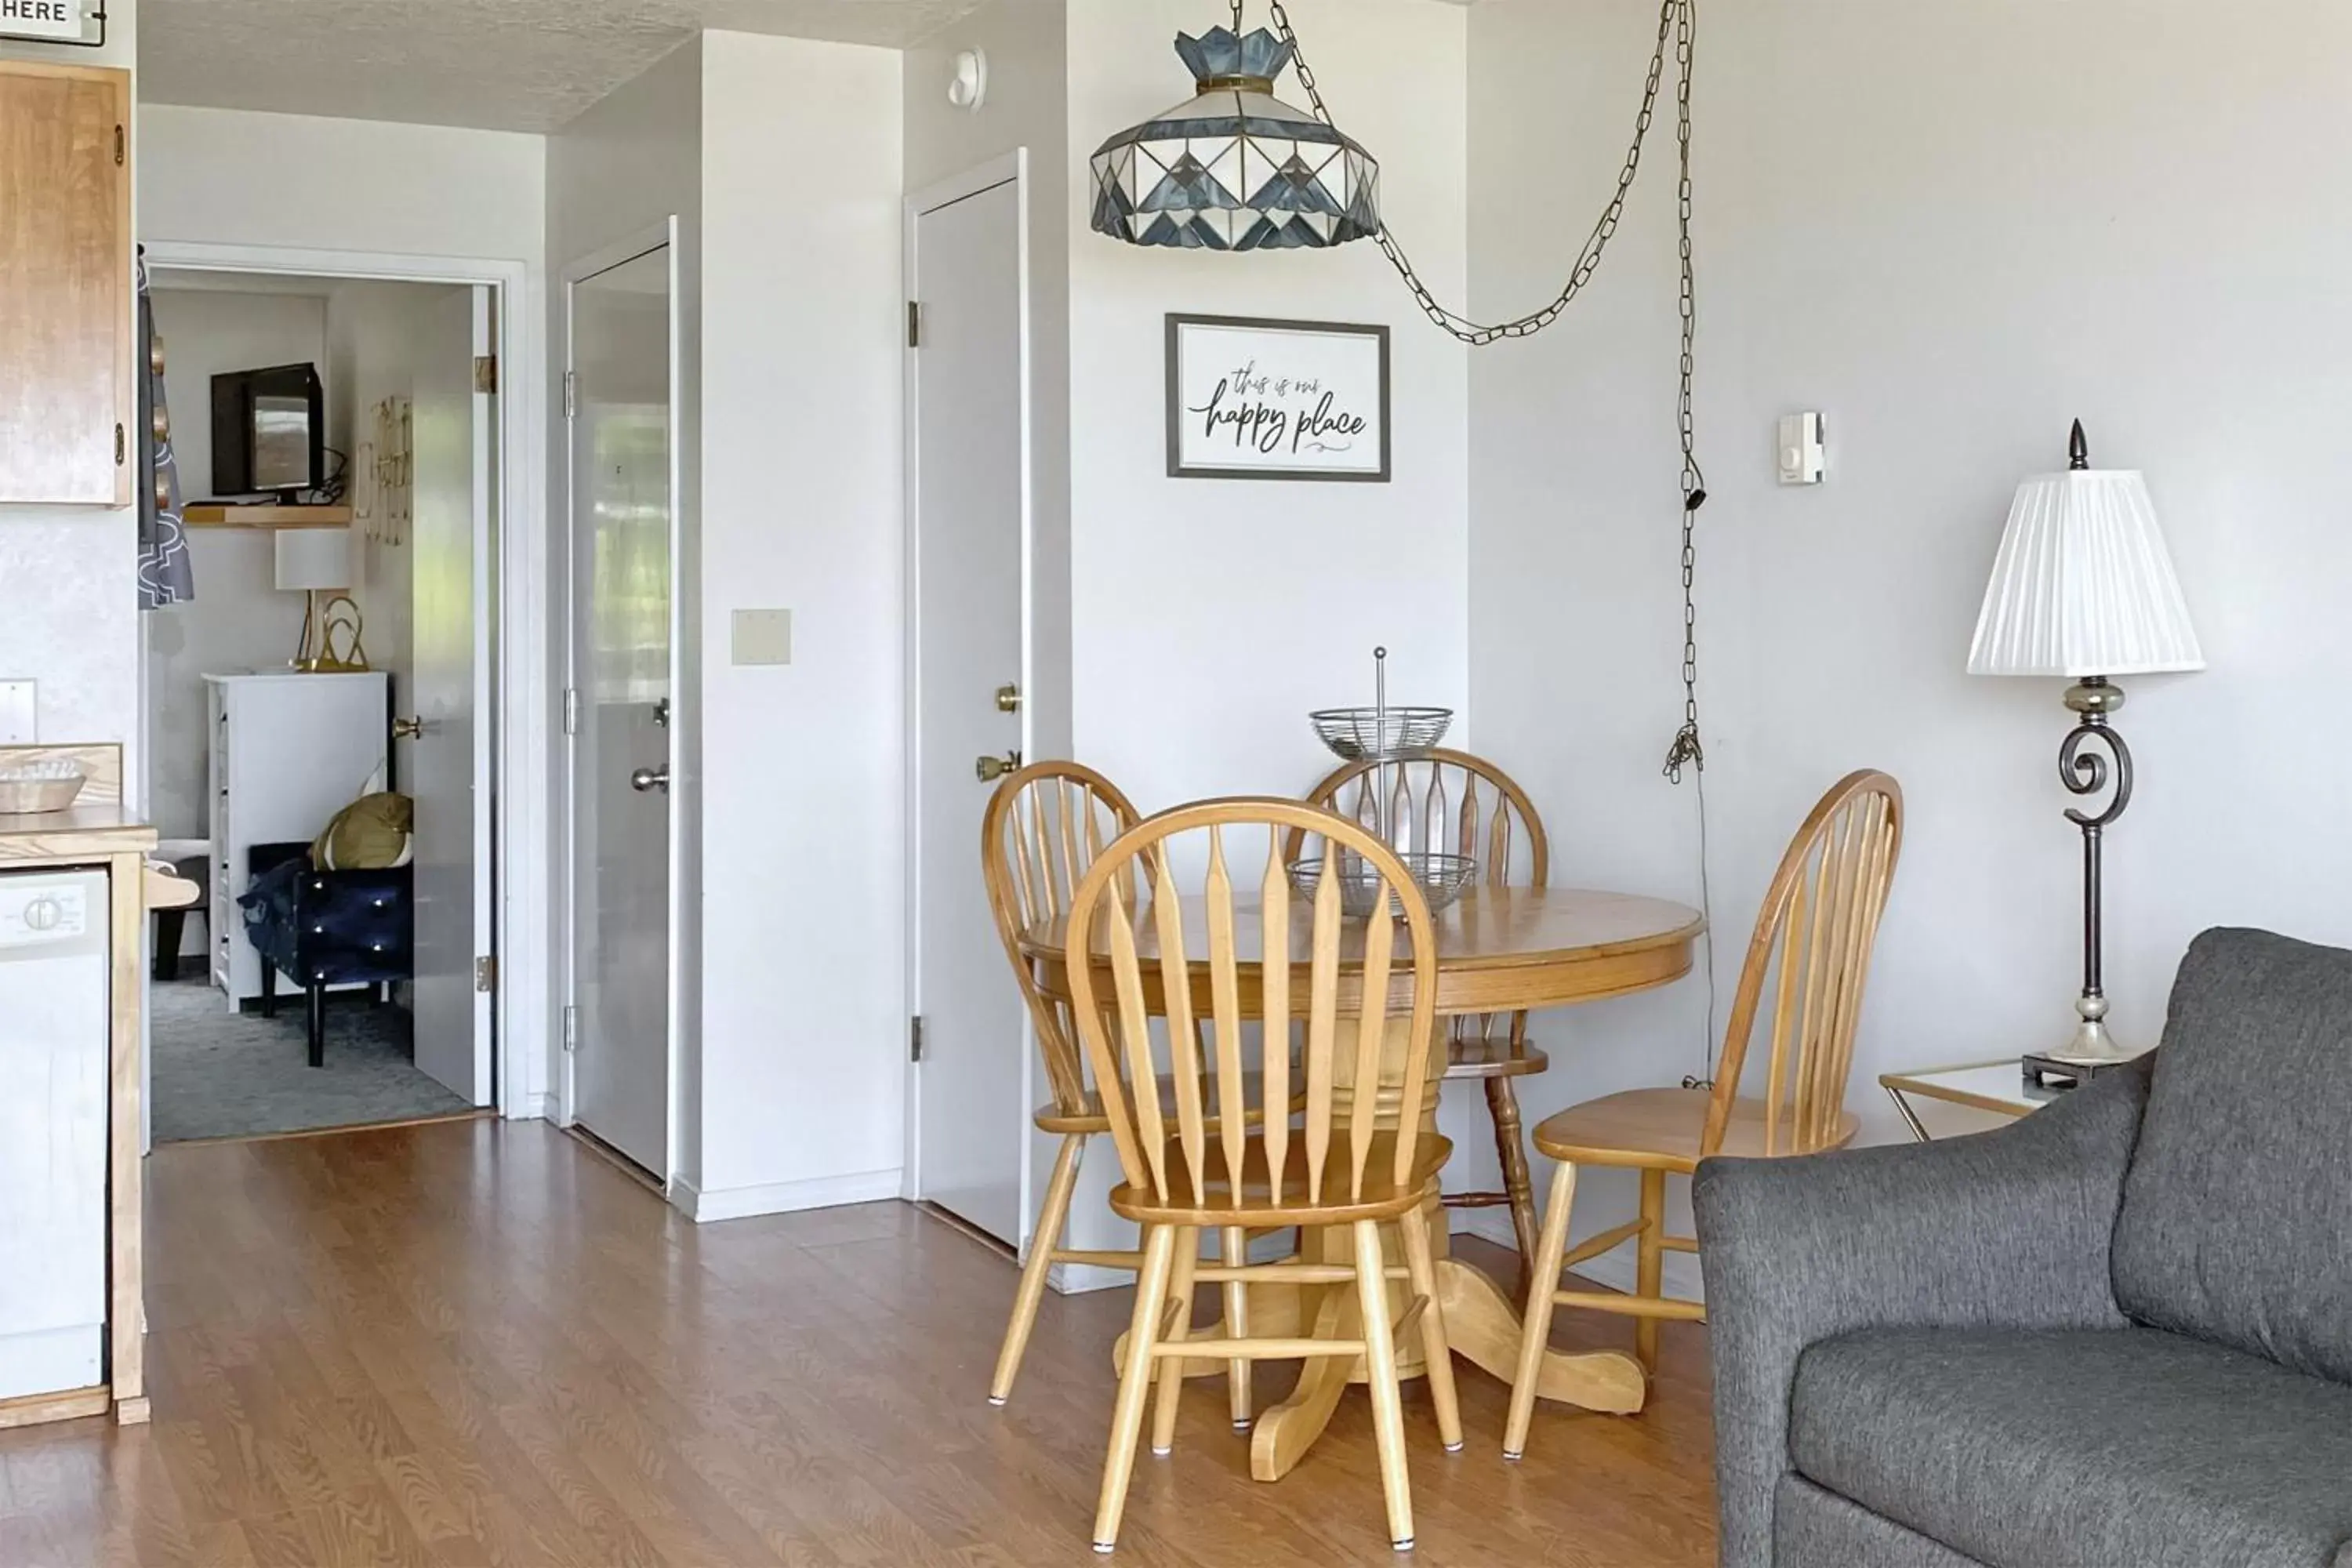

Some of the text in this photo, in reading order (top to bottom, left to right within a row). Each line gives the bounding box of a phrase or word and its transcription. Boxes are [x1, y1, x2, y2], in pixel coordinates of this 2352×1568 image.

[2, 0, 66, 21] HERE
[1231, 360, 1270, 395] this
[1275, 379, 1291, 397] is
[1187, 378, 1366, 454] happy place
